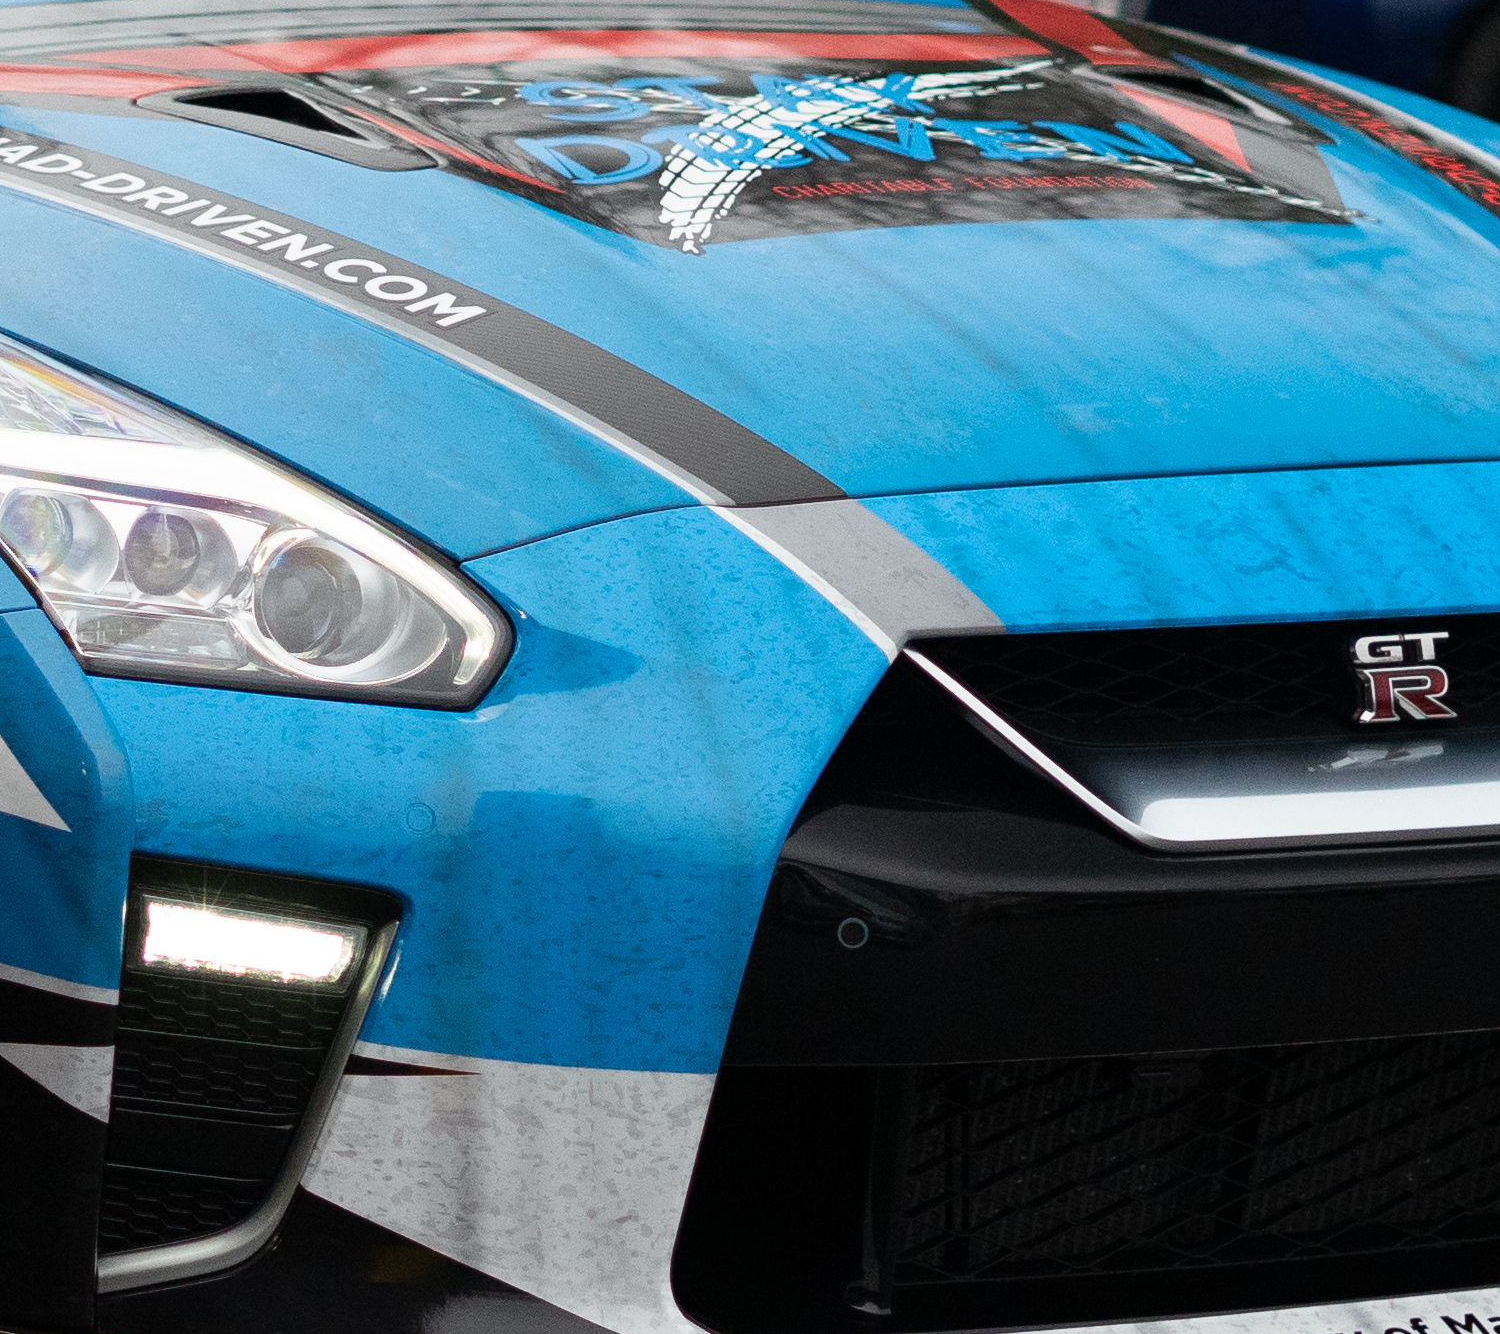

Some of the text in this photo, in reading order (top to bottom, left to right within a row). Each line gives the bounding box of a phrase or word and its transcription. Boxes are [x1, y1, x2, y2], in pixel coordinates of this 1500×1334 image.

[513, 114, 1197, 185] DRIVEN
[772, 175, 1157, 199] CHARITABLE FOUNDATION
[1354, 631, 1450, 664] GT
[1358, 665, 1458, 723] R
